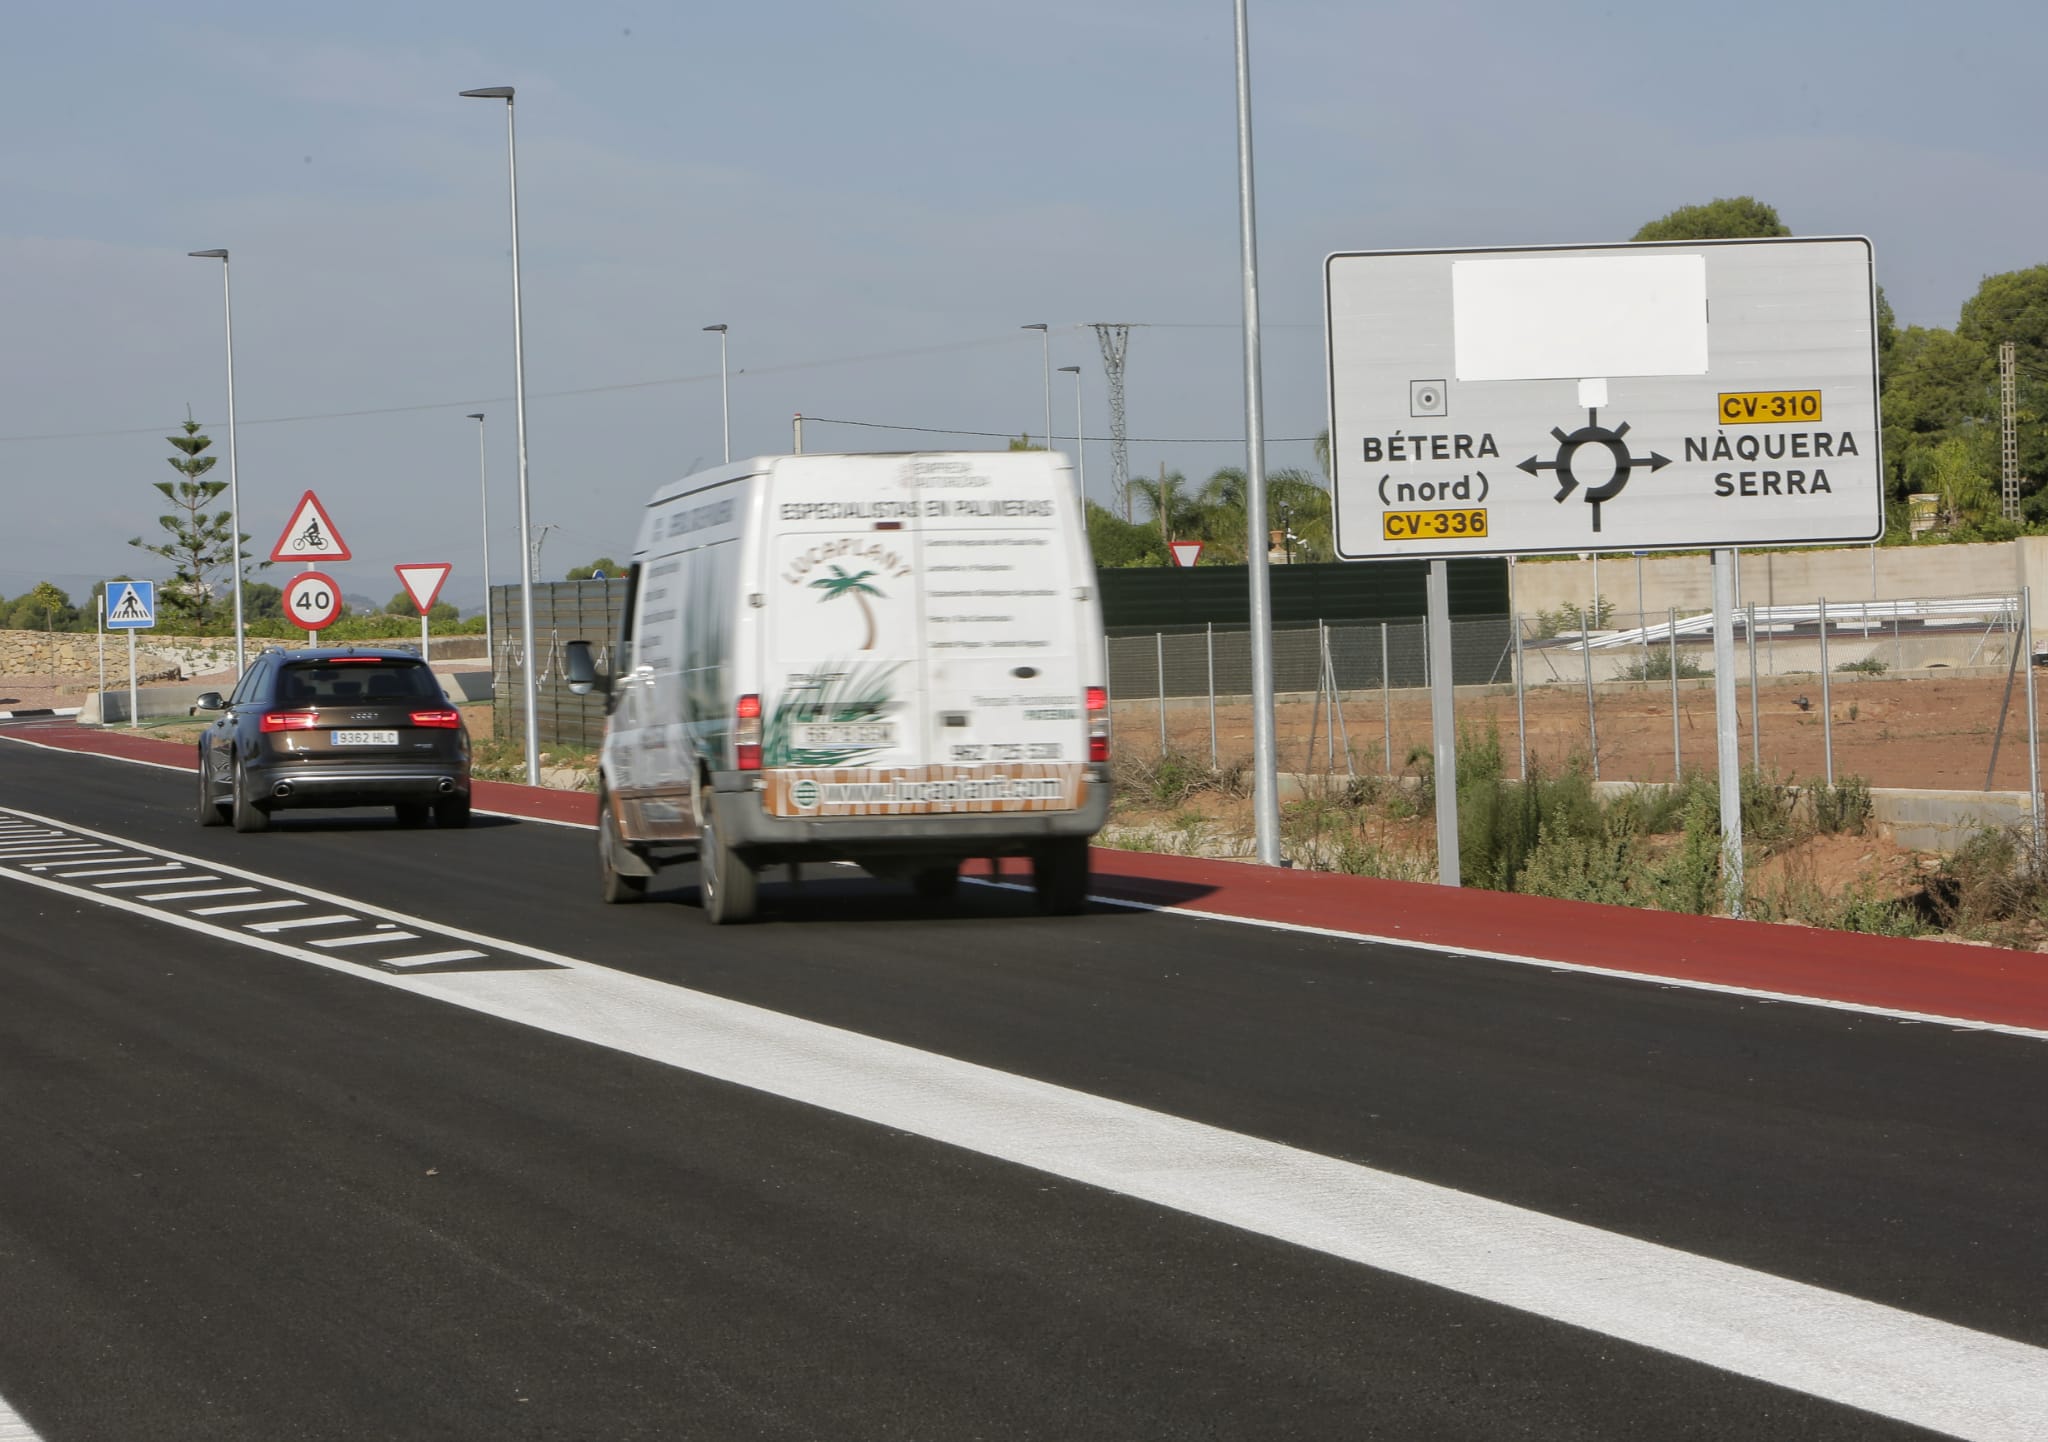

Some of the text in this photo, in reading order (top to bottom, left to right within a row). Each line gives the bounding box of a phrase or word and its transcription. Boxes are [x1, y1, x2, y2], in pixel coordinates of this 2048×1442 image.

[1723, 395, 1817, 418] CV-310
[1363, 430, 1500, 462] BÉTERA
[1684, 429, 1860, 462] NÀQUERA
[1378, 470, 1489, 506] (nord)
[1714, 469, 1832, 497] SERRA
[780, 500, 920, 520] ESPECIALISTAS
[955, 499, 1055, 518] PALMERAS
[1385, 511, 1485, 535] CV-336
[296, 591, 330, 610] 40
[340, 731, 395, 744] 9362 HLC
